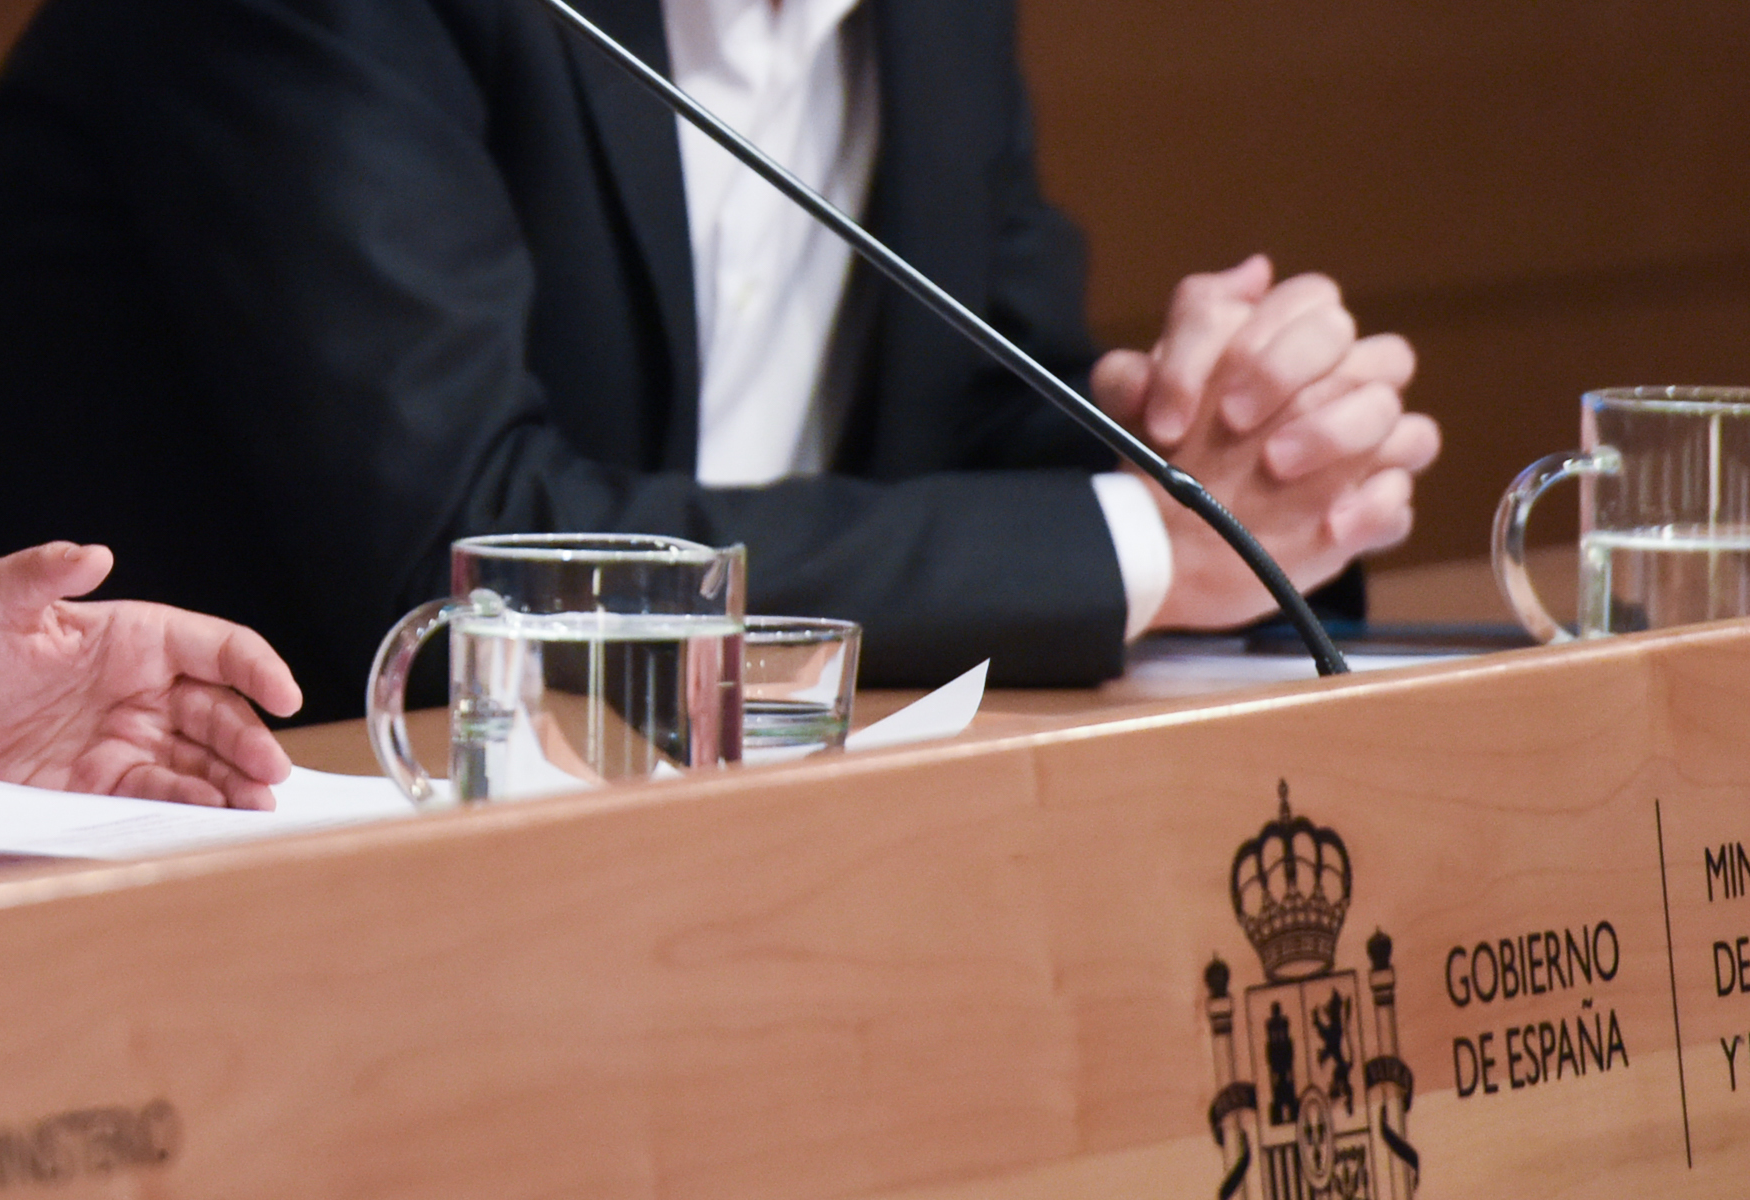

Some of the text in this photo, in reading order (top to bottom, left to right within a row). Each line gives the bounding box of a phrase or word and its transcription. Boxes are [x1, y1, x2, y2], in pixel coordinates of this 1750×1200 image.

[1446, 920, 1619, 1008] GOBIERNO
[1713, 936, 1750, 997] DE
[1453, 998, 1629, 1098] DE ESPAÑA
[1720, 1035, 1742, 1093] Y
